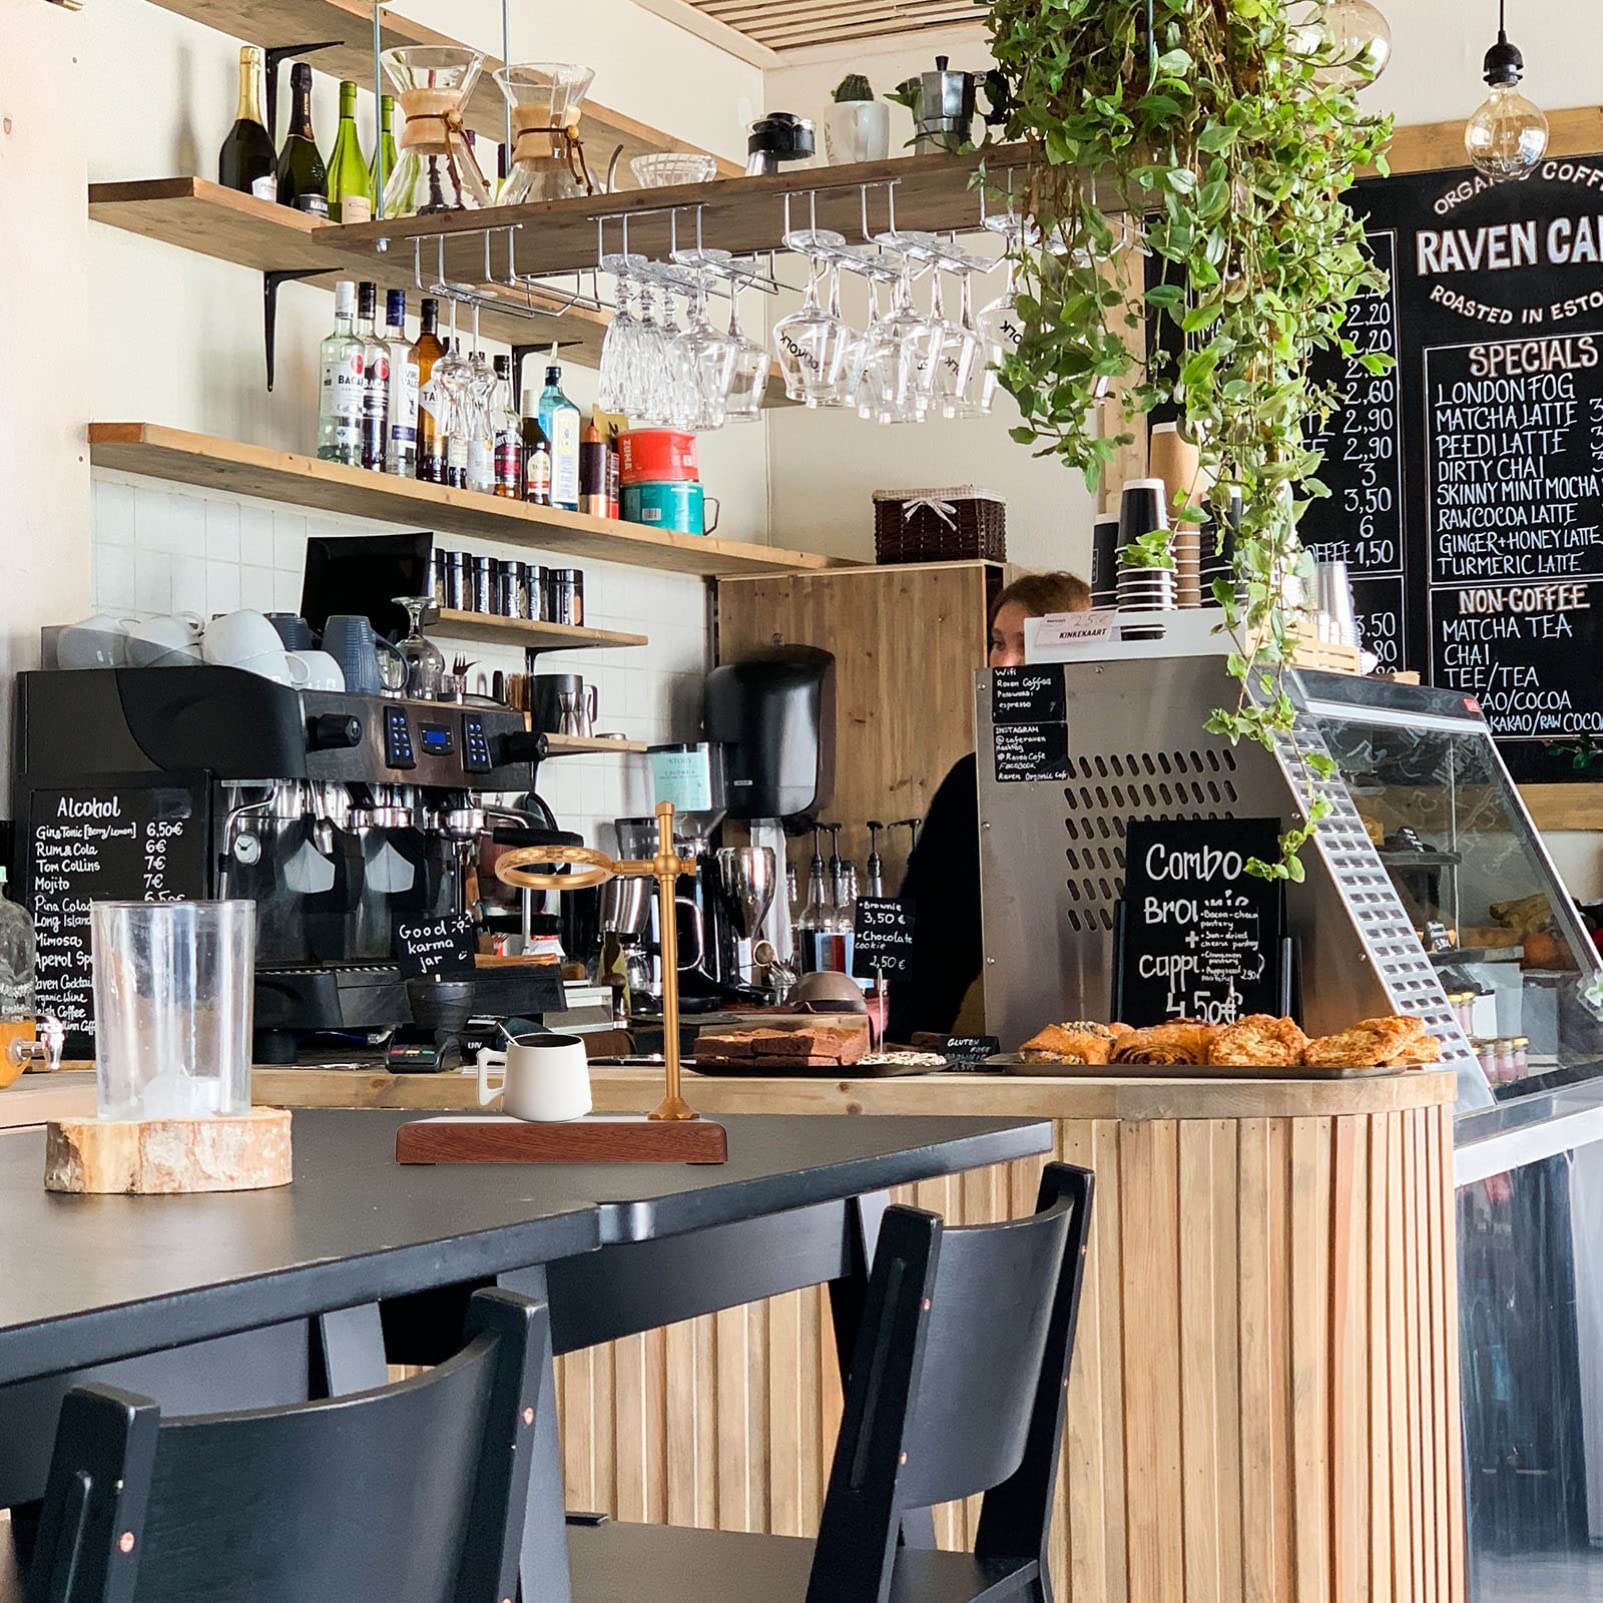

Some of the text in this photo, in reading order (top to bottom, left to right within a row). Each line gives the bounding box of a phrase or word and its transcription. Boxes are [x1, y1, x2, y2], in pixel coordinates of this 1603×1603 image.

[1433, 161, 1603, 215] ORGA COFF
[1416, 221, 1538, 276] RAVEN
[1430, 285, 1603, 324] ROASTED IN ESTO
[1468, 337, 1598, 377] SPECIALS
[1344, 381, 1393, 405] 2,60
[1435, 373, 1575, 407] LONDON FOG
[1344, 408, 1393, 434] 2,90
[1436, 404, 1518, 432] MATCHA
[1519, 401, 1578, 429] LATTE
[1343, 436, 1392, 461] 2,90
[1435, 434, 1496, 458] PEEDI
[1499, 429, 1569, 456] LATTE
[1358, 463, 1377, 486] 3
[1438, 460, 1493, 482] DIRTY
[1497, 456, 1544, 480] CHAI
[1344, 487, 1392, 514] 3,50
[1437, 474, 1600, 505] SKINNY MINT MOCHA
[1531, 503, 1578, 526] LATTE
[1360, 515, 1374, 538] 6
[1564, 525, 1603, 548] LATTE
[1355, 540, 1394, 567] 1,50
[1437, 552, 1584, 576] TURMERIC LATTE
[1459, 584, 1591, 615] NON-COFFEE
[1442, 613, 1572, 642] MATCHA TEA
[1444, 643, 1490, 666] CHAI
[1444, 661, 1539, 692] TEE/TEA
[1563, 712, 1603, 732] COCO
[57, 795, 121, 819] Alcohol
[146, 839, 167, 853] 6€
[36, 856, 166, 873] Tom Collins 7€
[1145, 843, 1242, 882] Combo
[35, 873, 163, 894] Mojito 7€
[62, 897, 93, 912] Colad
[34, 912, 60, 933] Long
[399, 920, 447, 940] Good
[864, 912, 895, 925] 3,50
[35, 932, 82, 948] Mimosa
[408, 938, 454, 955] karma
[855, 941, 886, 950] cookie
[863, 930, 912, 944] Chocolate
[35, 952, 72, 972] Aperol
[420, 955, 443, 974] jar
[57, 1005, 86, 1020] Coffee
